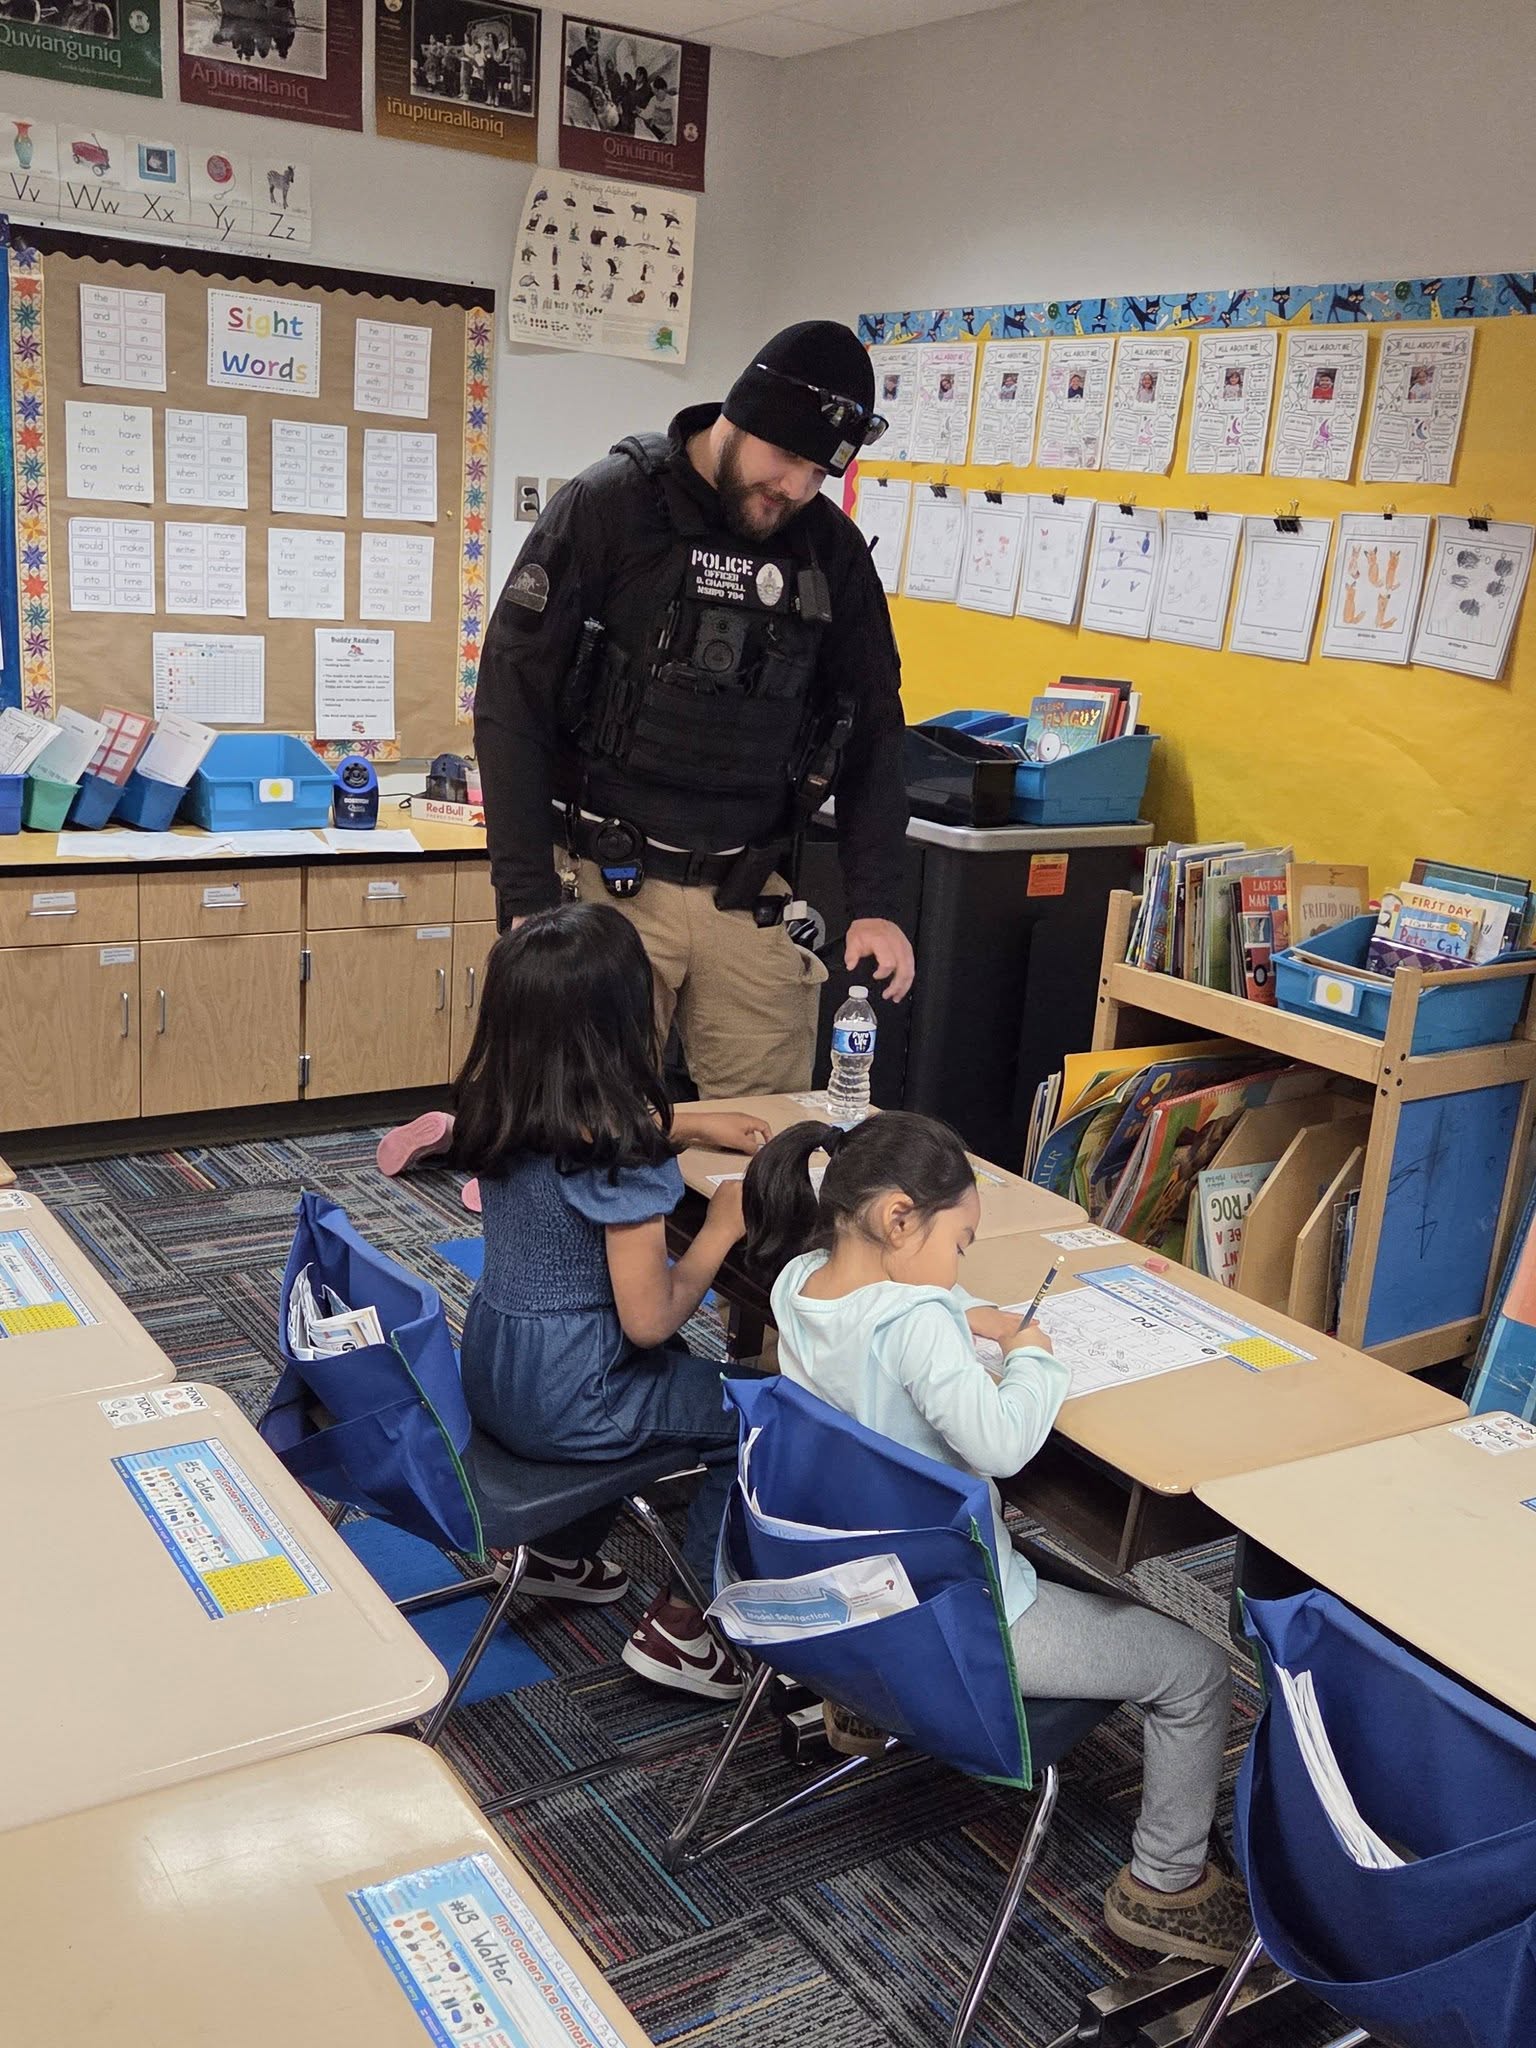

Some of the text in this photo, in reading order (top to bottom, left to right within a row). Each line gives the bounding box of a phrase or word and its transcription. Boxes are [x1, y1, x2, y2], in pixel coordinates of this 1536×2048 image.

[228, 306, 303, 338] Sight
[1420, 341, 1440, 349] ABOUT
[136, 353, 152, 361] you
[223, 351, 307, 381] Words
[123, 412, 136, 422] be
[119, 429, 141, 440] have
[78, 442, 100, 453] from
[122, 464, 140, 474] had
[83, 480, 95, 490] by
[119, 482, 144, 491] words
[83, 558, 98, 567] like
[125, 560, 141, 569] him
[692, 549, 753, 576] POLICE
[704, 569, 739, 582] OFFICER
[705, 578, 746, 592] CHAPPELL
[84, 592, 99, 601] has
[1069, 709, 1100, 726] GUY
[426, 802, 463, 816] Red Bull
[1253, 880, 1271, 892] LAST
[1302, 902, 1337, 920] FRIEND
[1412, 897, 1472, 918] FIRST DAY
[1400, 926, 1461, 956] Pete Cat
[1216, 1228, 1241, 1245] BE A
[184, 1387, 206, 1408] PENNY
[1504, 1416, 1536, 1434] PENN
[193, 1475, 217, 1503] Jolene
[222, 1481, 241, 1507] Graders
[775, 1612, 830, 1622] Subtraction
[470, 1931, 513, 1986] Walter
[492, 1914, 516, 1938] First
[510, 1936, 545, 1982] Graders
[540, 1984, 560, 2006] Are
